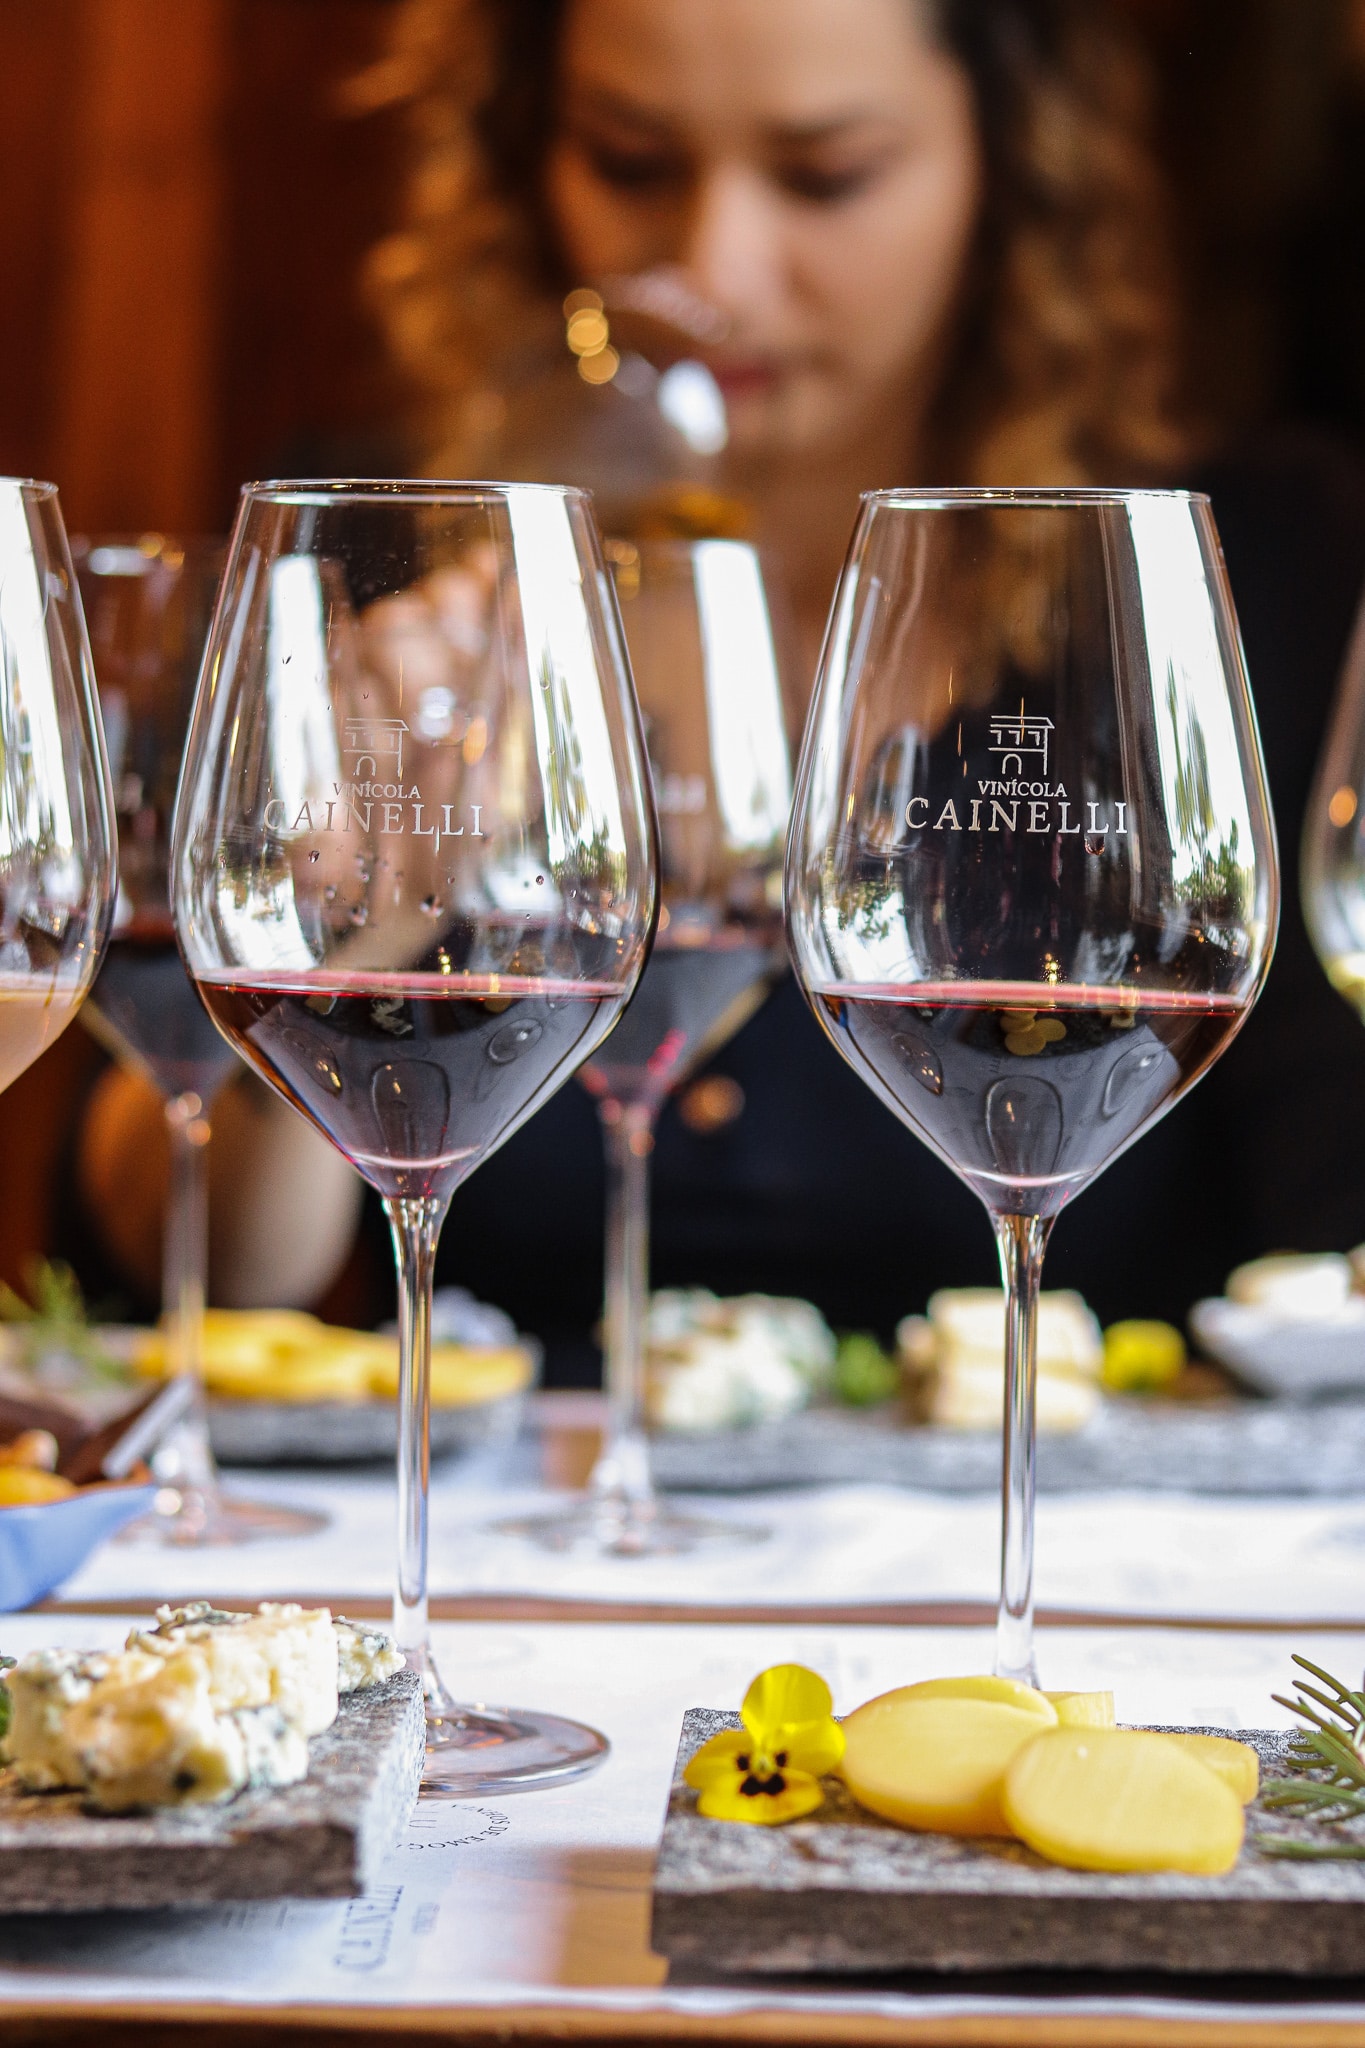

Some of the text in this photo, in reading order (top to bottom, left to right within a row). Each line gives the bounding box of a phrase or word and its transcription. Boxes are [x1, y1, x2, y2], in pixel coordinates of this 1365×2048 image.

[333, 780, 421, 799] VINÍCOLA
[977, 778, 1068, 798] VINÍCOLA
[263, 798, 484, 836] CAINELLI
[904, 797, 1128, 834] CAINELLI
